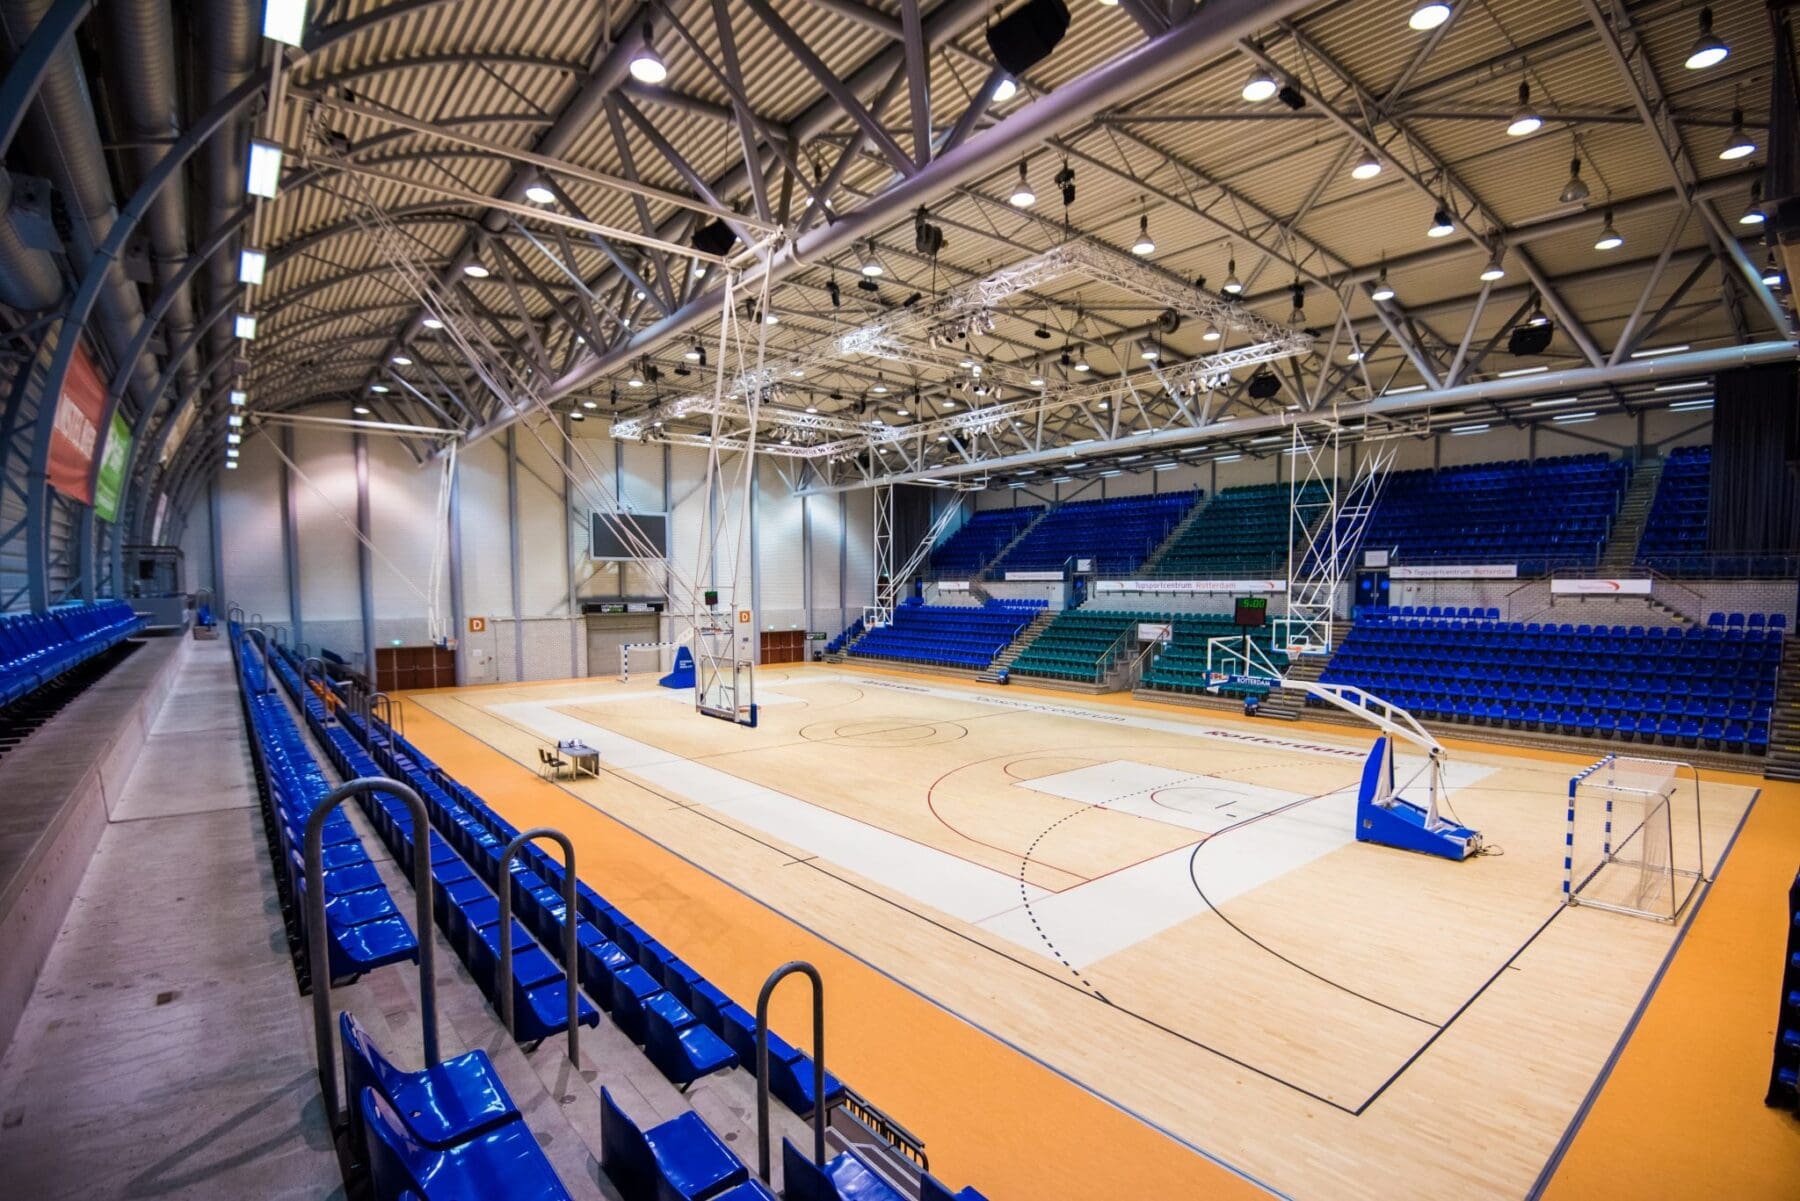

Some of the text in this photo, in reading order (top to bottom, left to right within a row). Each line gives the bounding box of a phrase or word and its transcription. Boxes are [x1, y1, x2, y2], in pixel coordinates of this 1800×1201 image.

[742, 612, 748, 621] D
[473, 619, 482, 630] D
[1237, 677, 1271, 687] ROTTERDAM
